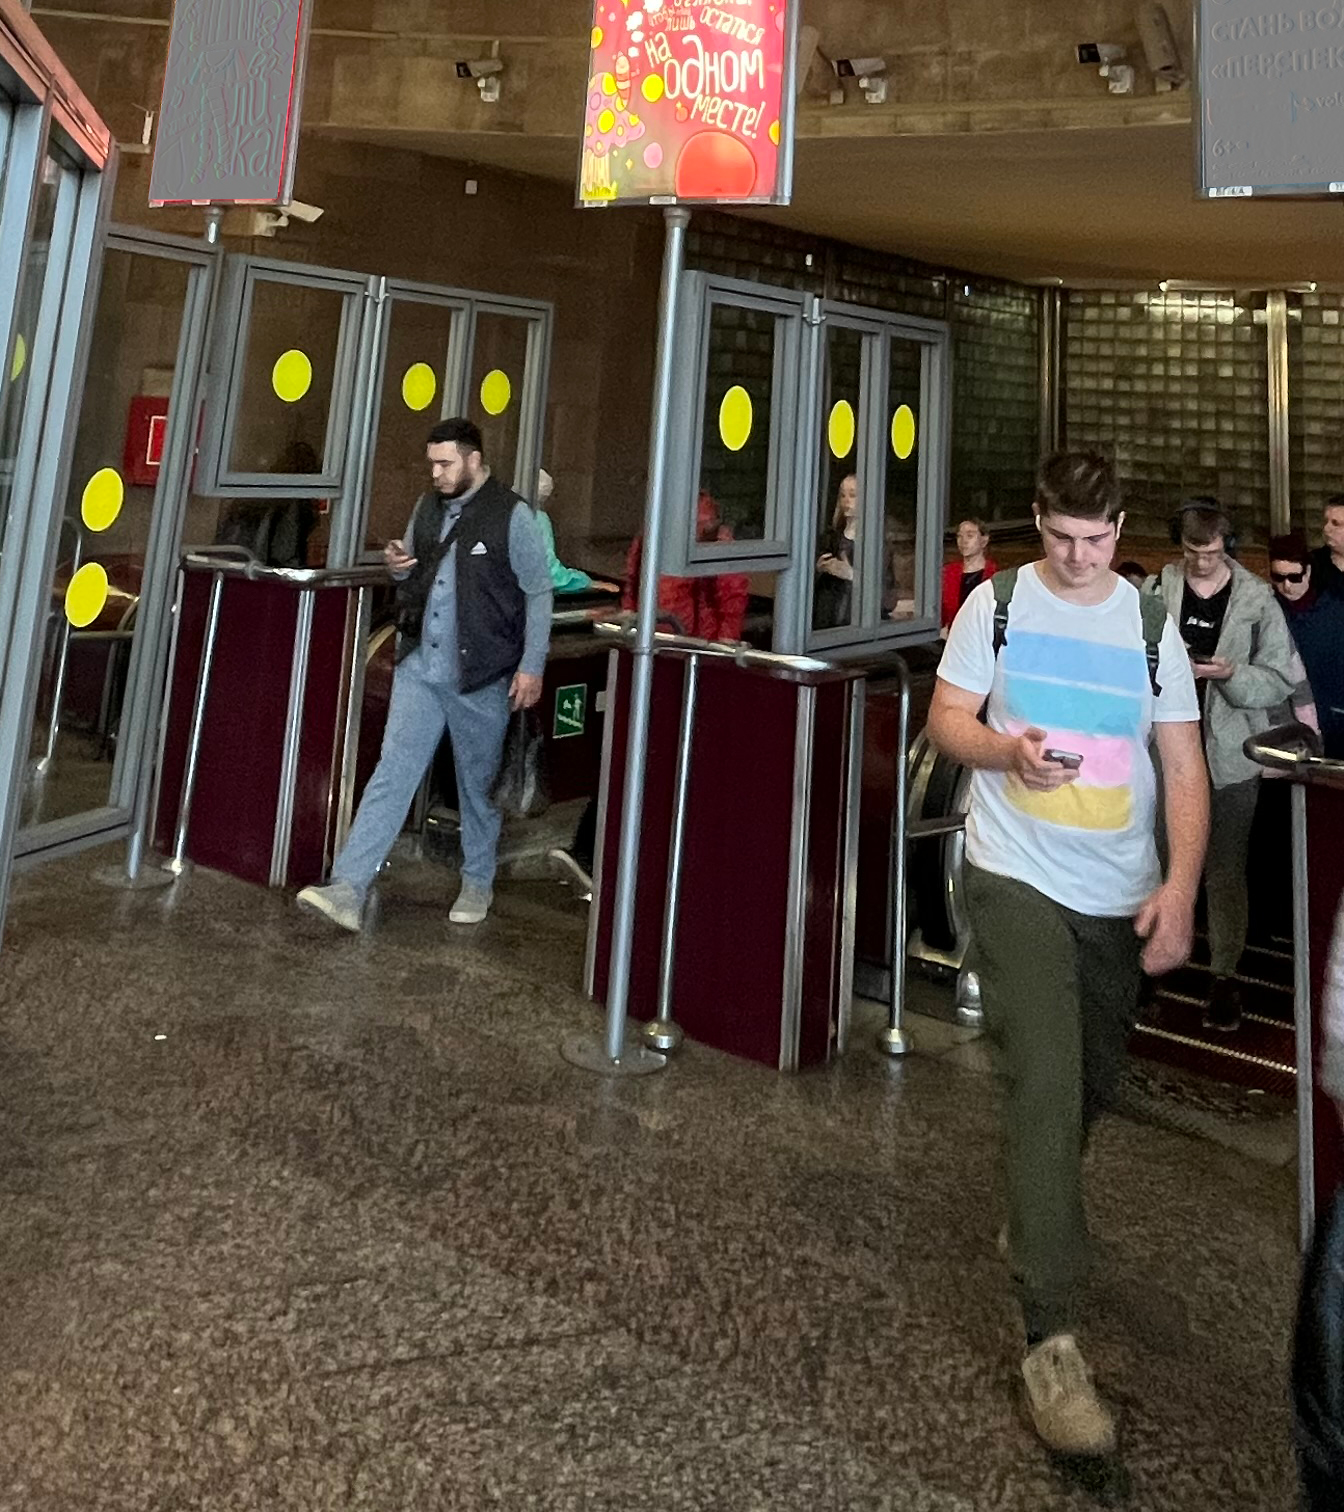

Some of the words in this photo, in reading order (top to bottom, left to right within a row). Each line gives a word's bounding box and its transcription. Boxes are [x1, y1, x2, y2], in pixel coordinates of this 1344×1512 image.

[644, 32, 672, 68] на
[664, 34, 764, 99] одном
[691, 93, 766, 139] месте!
